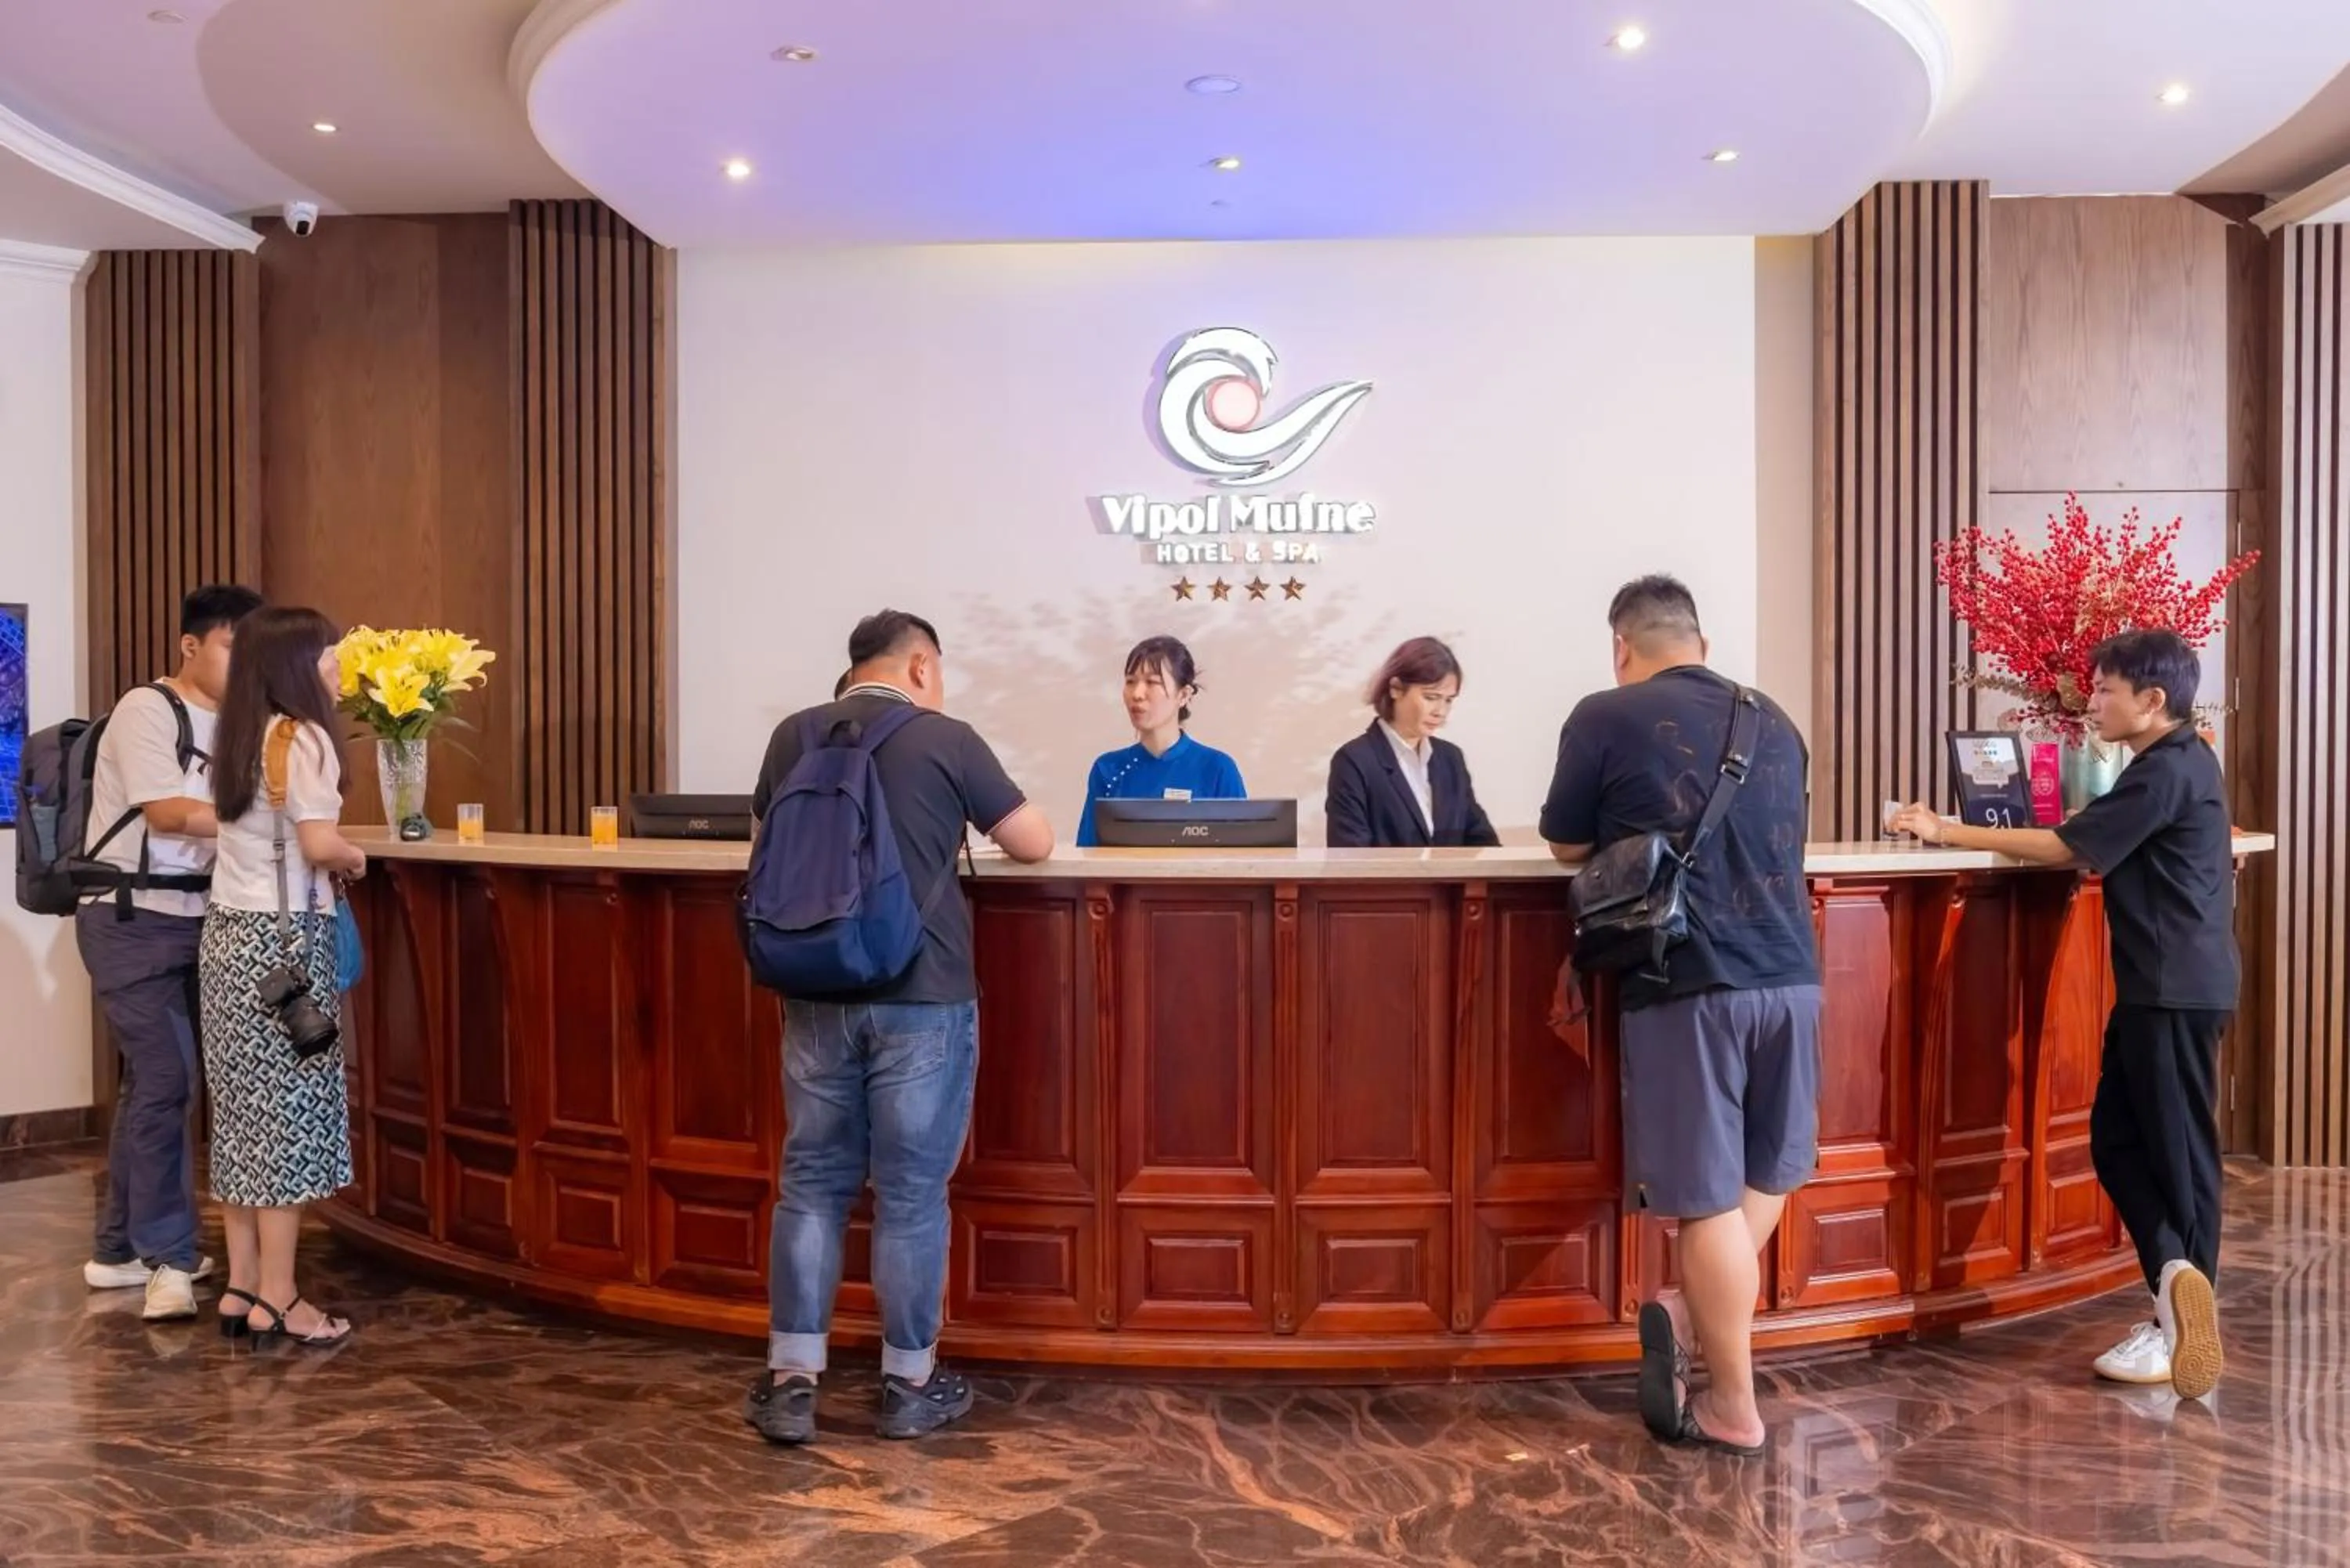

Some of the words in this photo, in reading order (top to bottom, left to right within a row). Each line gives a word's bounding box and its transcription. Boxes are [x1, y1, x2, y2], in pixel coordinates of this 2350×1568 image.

[1101, 494, 1220, 540] Vipol
[1156, 541, 1234, 563] HOTEL
[1245, 541, 1261, 563] &
[1272, 540, 1321, 563] SPA
[688, 819, 710, 830] AOC
[1181, 826, 1209, 836] AOC
